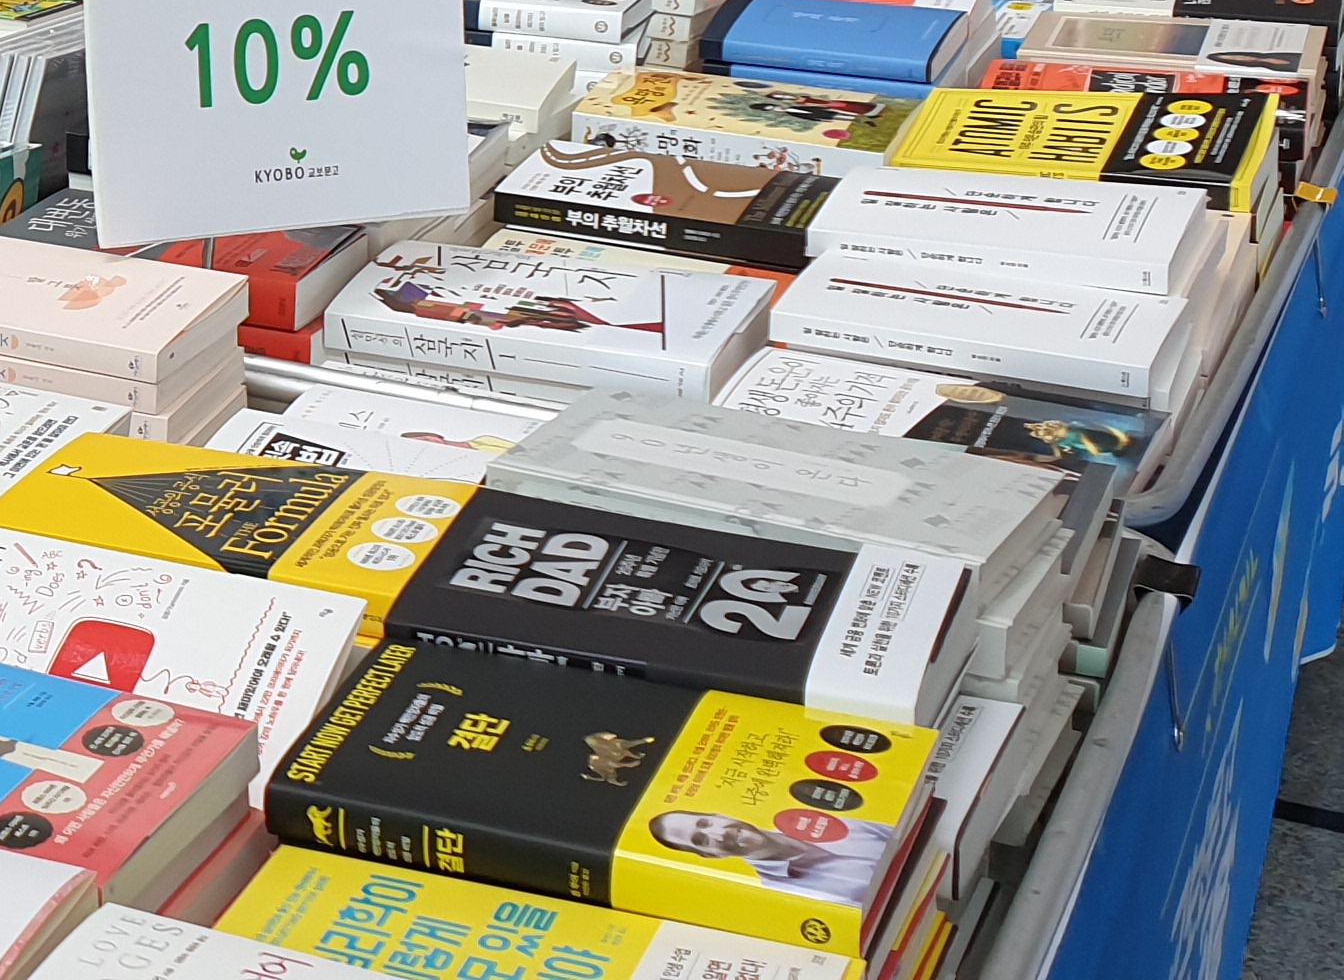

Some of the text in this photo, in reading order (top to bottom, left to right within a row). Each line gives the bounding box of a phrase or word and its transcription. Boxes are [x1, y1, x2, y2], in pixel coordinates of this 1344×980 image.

[184, 9, 371, 109] 10%
[949, 99, 1038, 157] ATOMIC
[1025, 103, 1118, 163] HABITS
[254, 164, 340, 184] KYOBO 교보문고
[547, 175, 592, 196] 부의
[574, 165, 644, 201] 추월차선
[565, 209, 667, 239] 부의 추월차선
[413, 334, 483, 360] 삼국지
[844, 371, 897, 396] 기적
[138, 470, 210, 517] 성공의 공식
[156, 467, 282, 538] 포뮬러
[220, 473, 348, 558] Formula
[233, 521, 259, 537] THE
[451, 523, 545, 593] RICH
[511, 533, 623, 606] DAD
[34, 567, 65, 598] Does
[121, 582, 161, 609] don't
[593, 583, 641, 611] 부자
[864, 583, 882, 599] NEW
[628, 588, 673, 616] 아빠
[28, 620, 55, 650] verbs
[844, 629, 865, 643] 금융
[877, 620, 897, 632] 위한
[839, 642, 859, 657] 세계
[870, 633, 892, 652] 실천을
[862, 652, 884, 676] 토론과
[286, 644, 416, 783] START NOW GET PERFECT LATER
[448, 713, 510, 751] 결단
[740, 776, 774, 806] 나중에
[435, 828, 468, 874] 결단
[78, 914, 146, 968] LOVE
[478, 902, 557, 957] 있을
